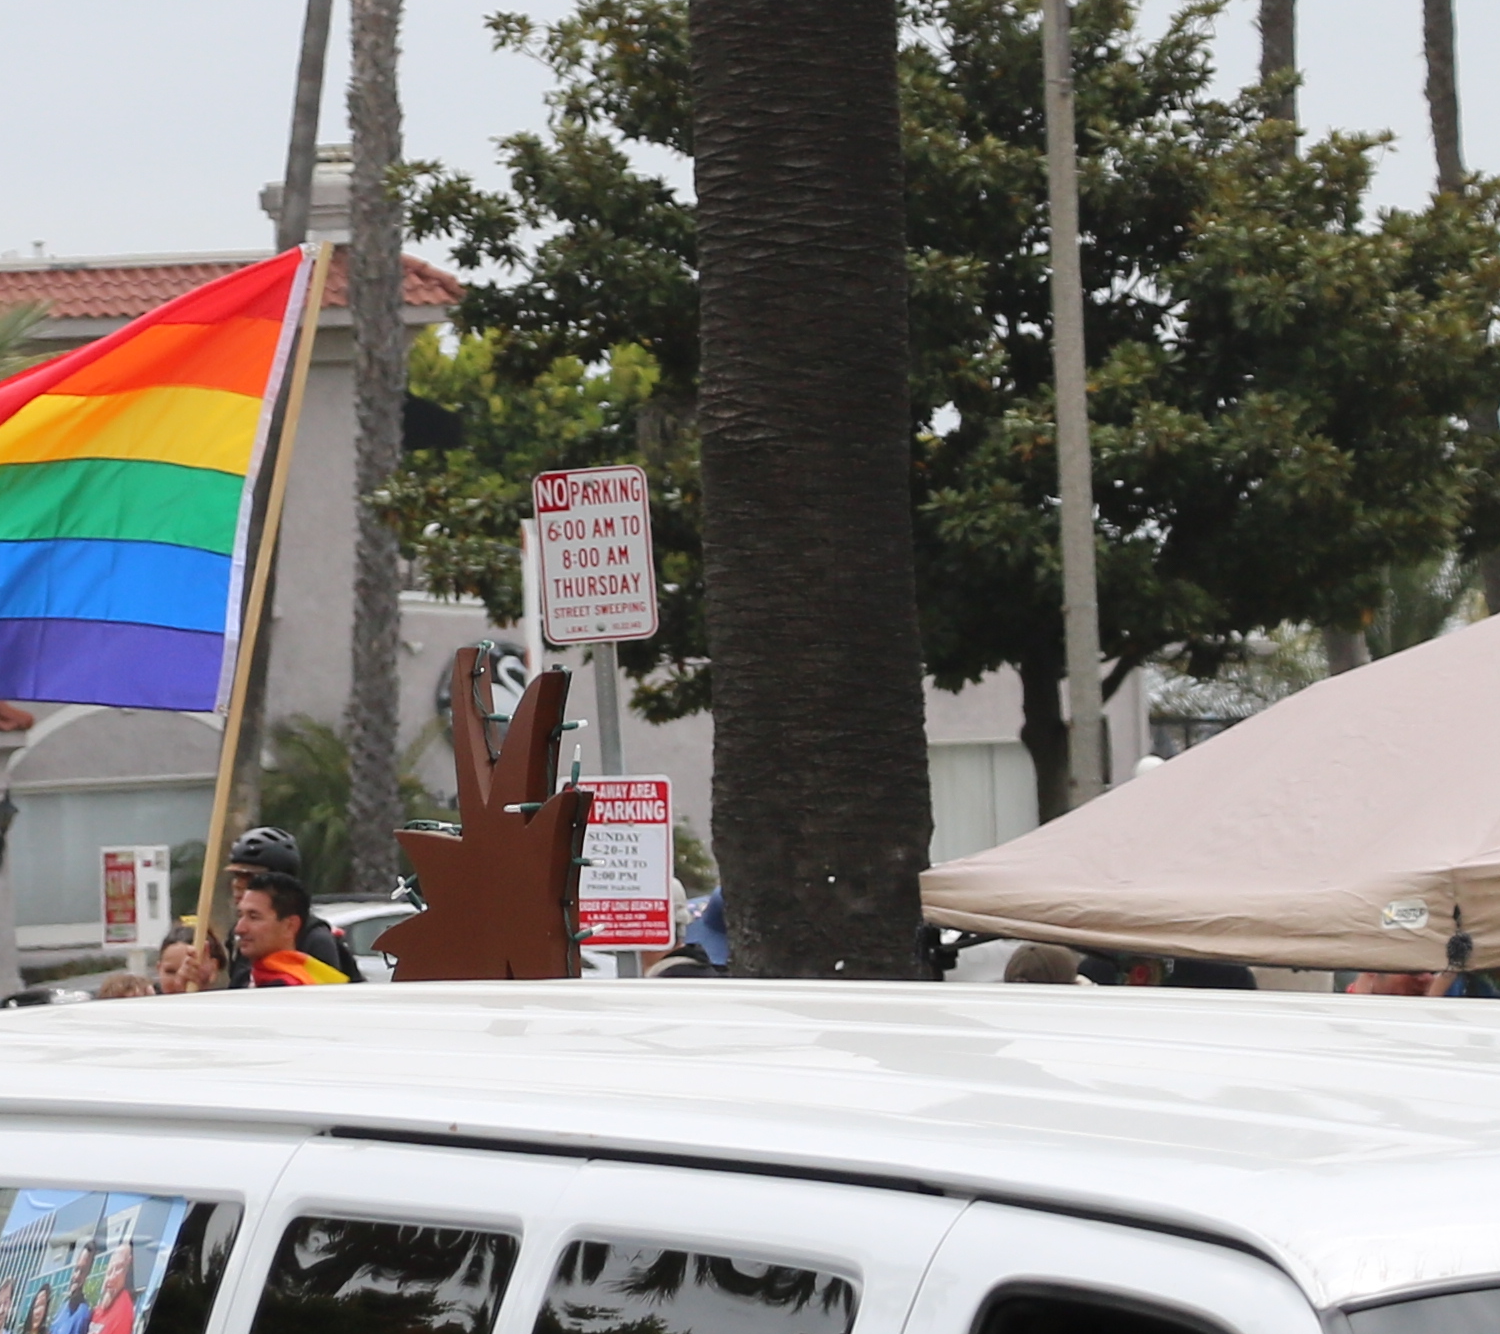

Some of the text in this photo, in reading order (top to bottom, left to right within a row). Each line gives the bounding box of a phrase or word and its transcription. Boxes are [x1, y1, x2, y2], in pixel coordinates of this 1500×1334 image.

[537, 477, 641, 508] NO PARKING
[547, 515, 640, 542] 6:00 AM TO
[562, 545, 630, 570] 8:00 AM
[553, 572, 641, 599] THURSDAY
[554, 601, 646, 619] STREET SWEEPING
[629, 783, 658, 798] AREA
[594, 800, 666, 821] PARKING
[587, 832, 641, 842] SUNDAY
